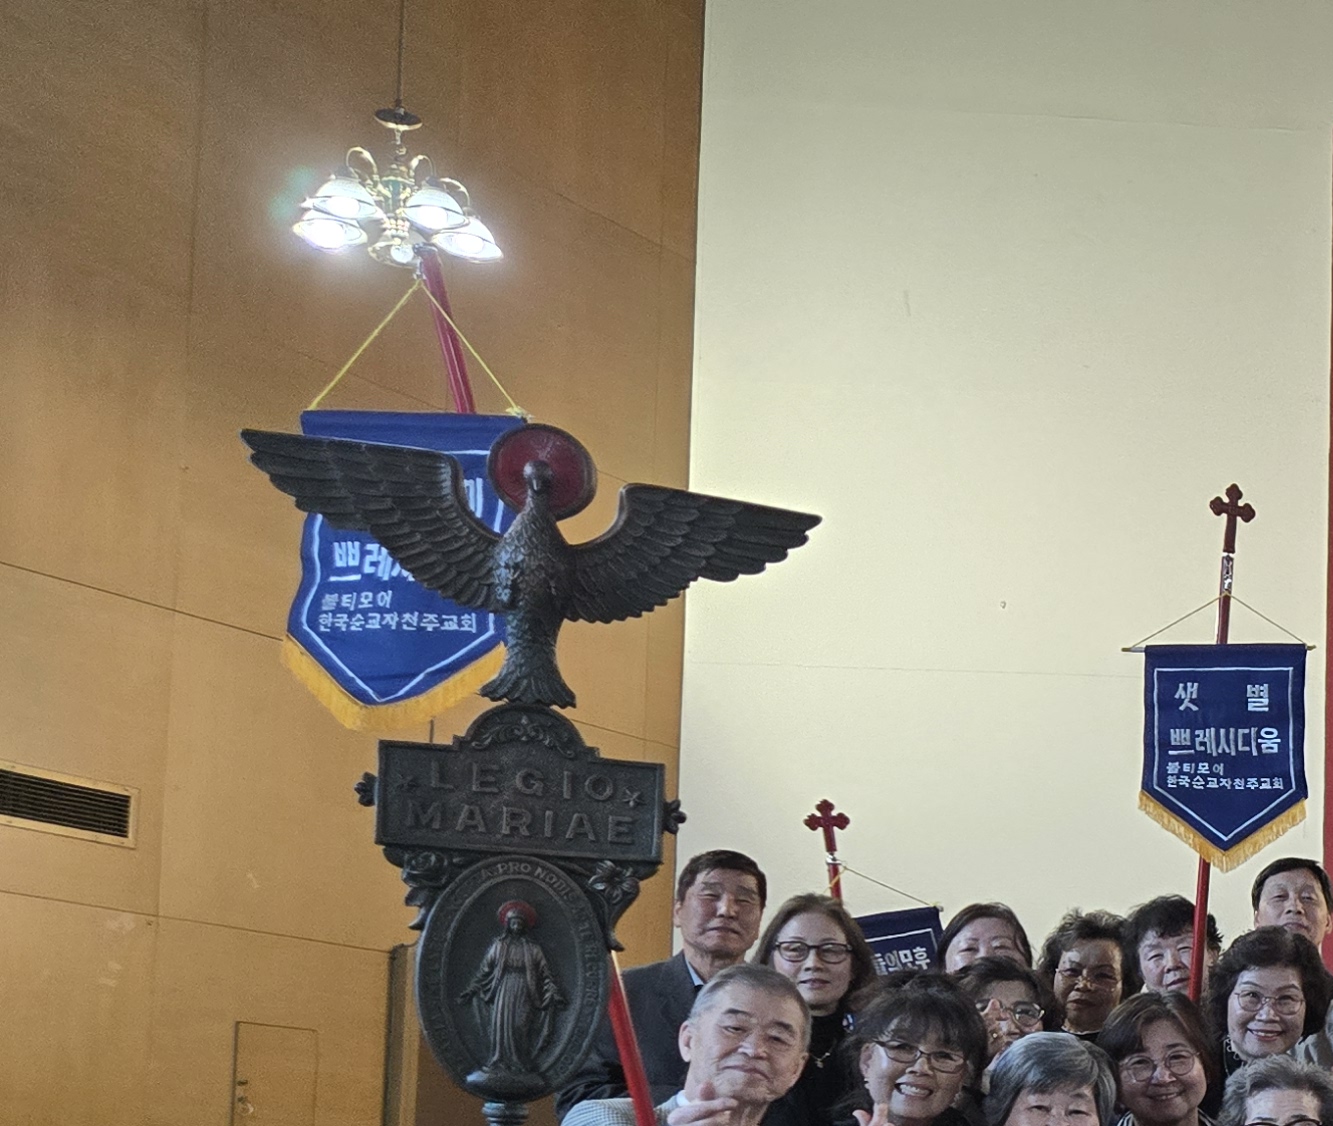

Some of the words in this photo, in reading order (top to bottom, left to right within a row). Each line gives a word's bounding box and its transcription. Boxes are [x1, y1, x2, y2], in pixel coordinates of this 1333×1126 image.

[321, 590, 392, 611] 볼티모어
[1168, 727, 1281, 756] 쁘레시디움
[430, 760, 613, 801] LEGIO
[1166, 762, 1224, 775] 볼티모어
[406, 802, 637, 844] MARIAE
